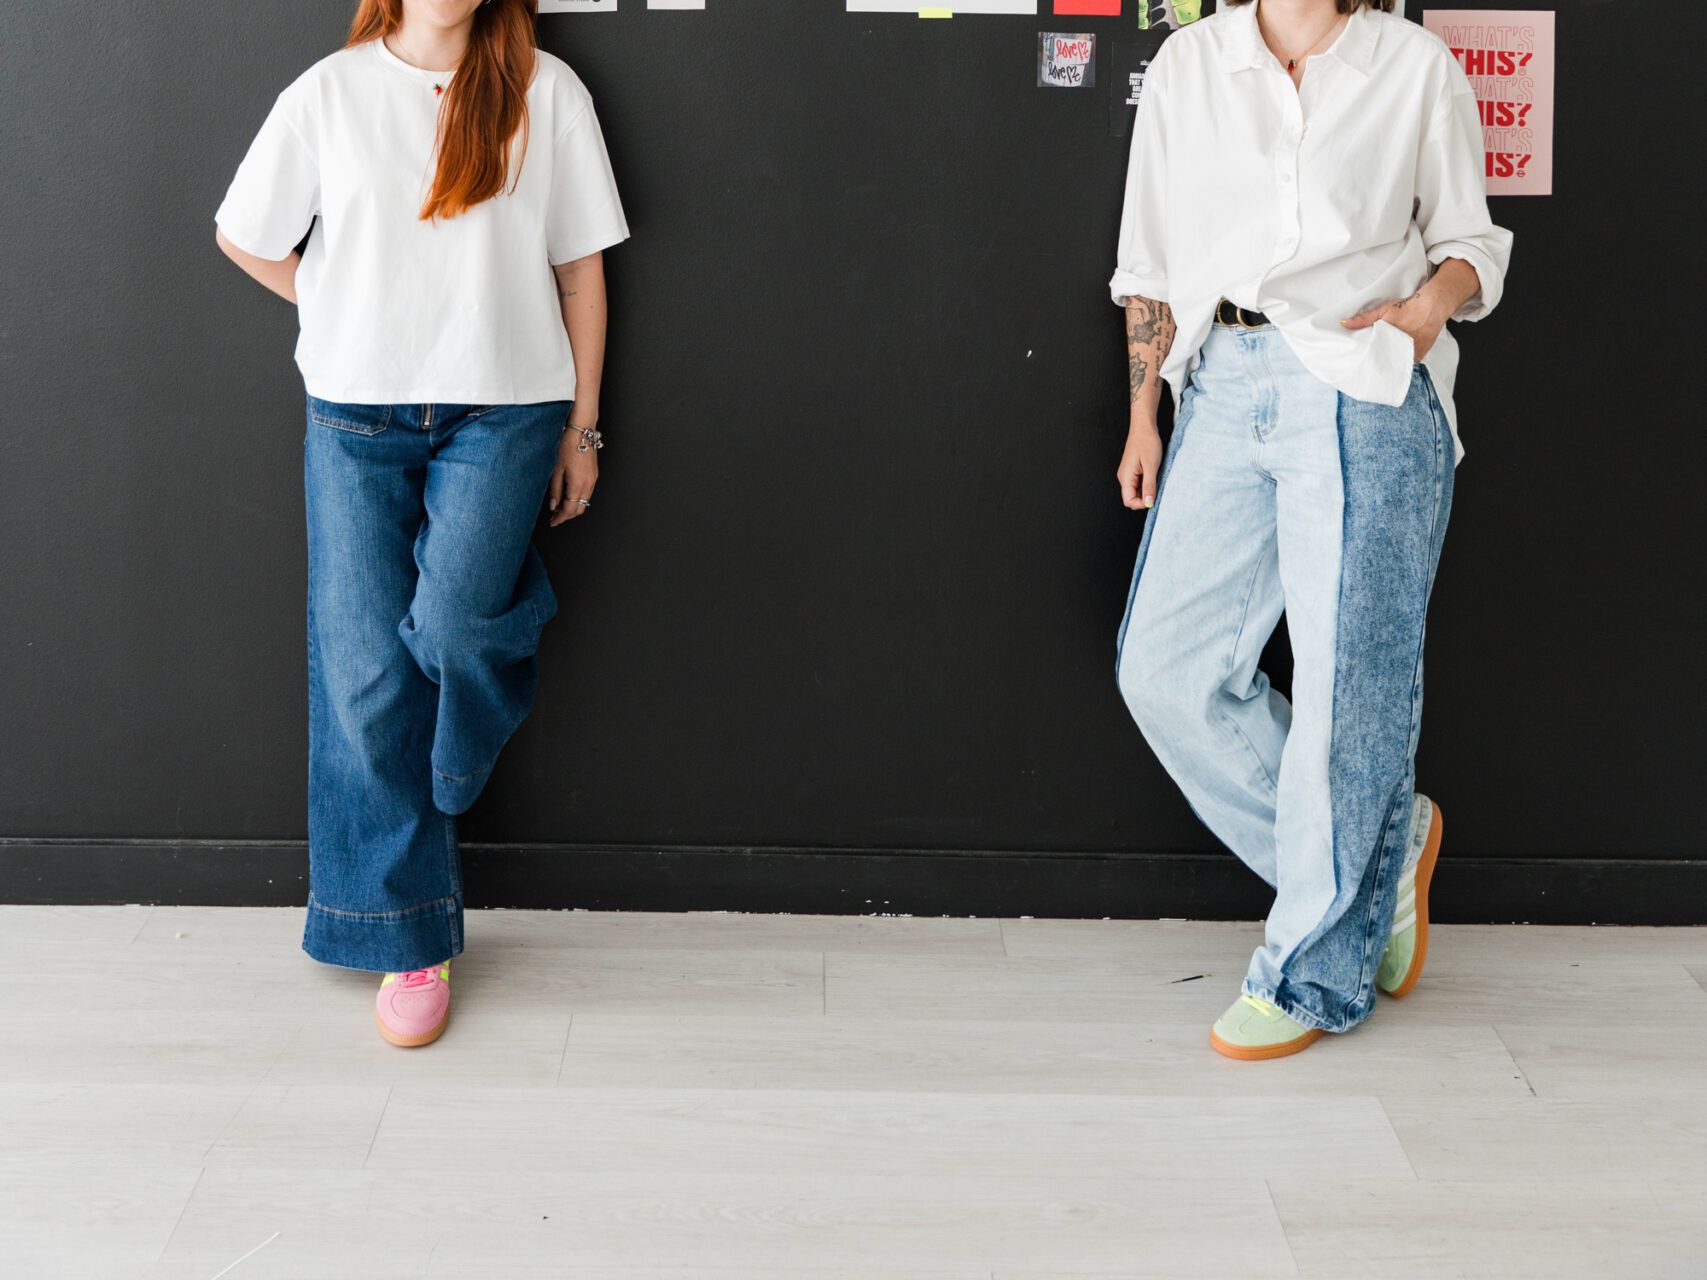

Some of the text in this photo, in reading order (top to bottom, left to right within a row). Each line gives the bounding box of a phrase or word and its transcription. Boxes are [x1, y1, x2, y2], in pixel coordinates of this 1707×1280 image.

[1443, 25, 1535, 50] WHAT'S
[1468, 77, 1533, 102] HAT'S
[1477, 100, 1532, 127] IS?
[1484, 128, 1533, 153] AT'S
[1486, 152, 1531, 178] IS?
